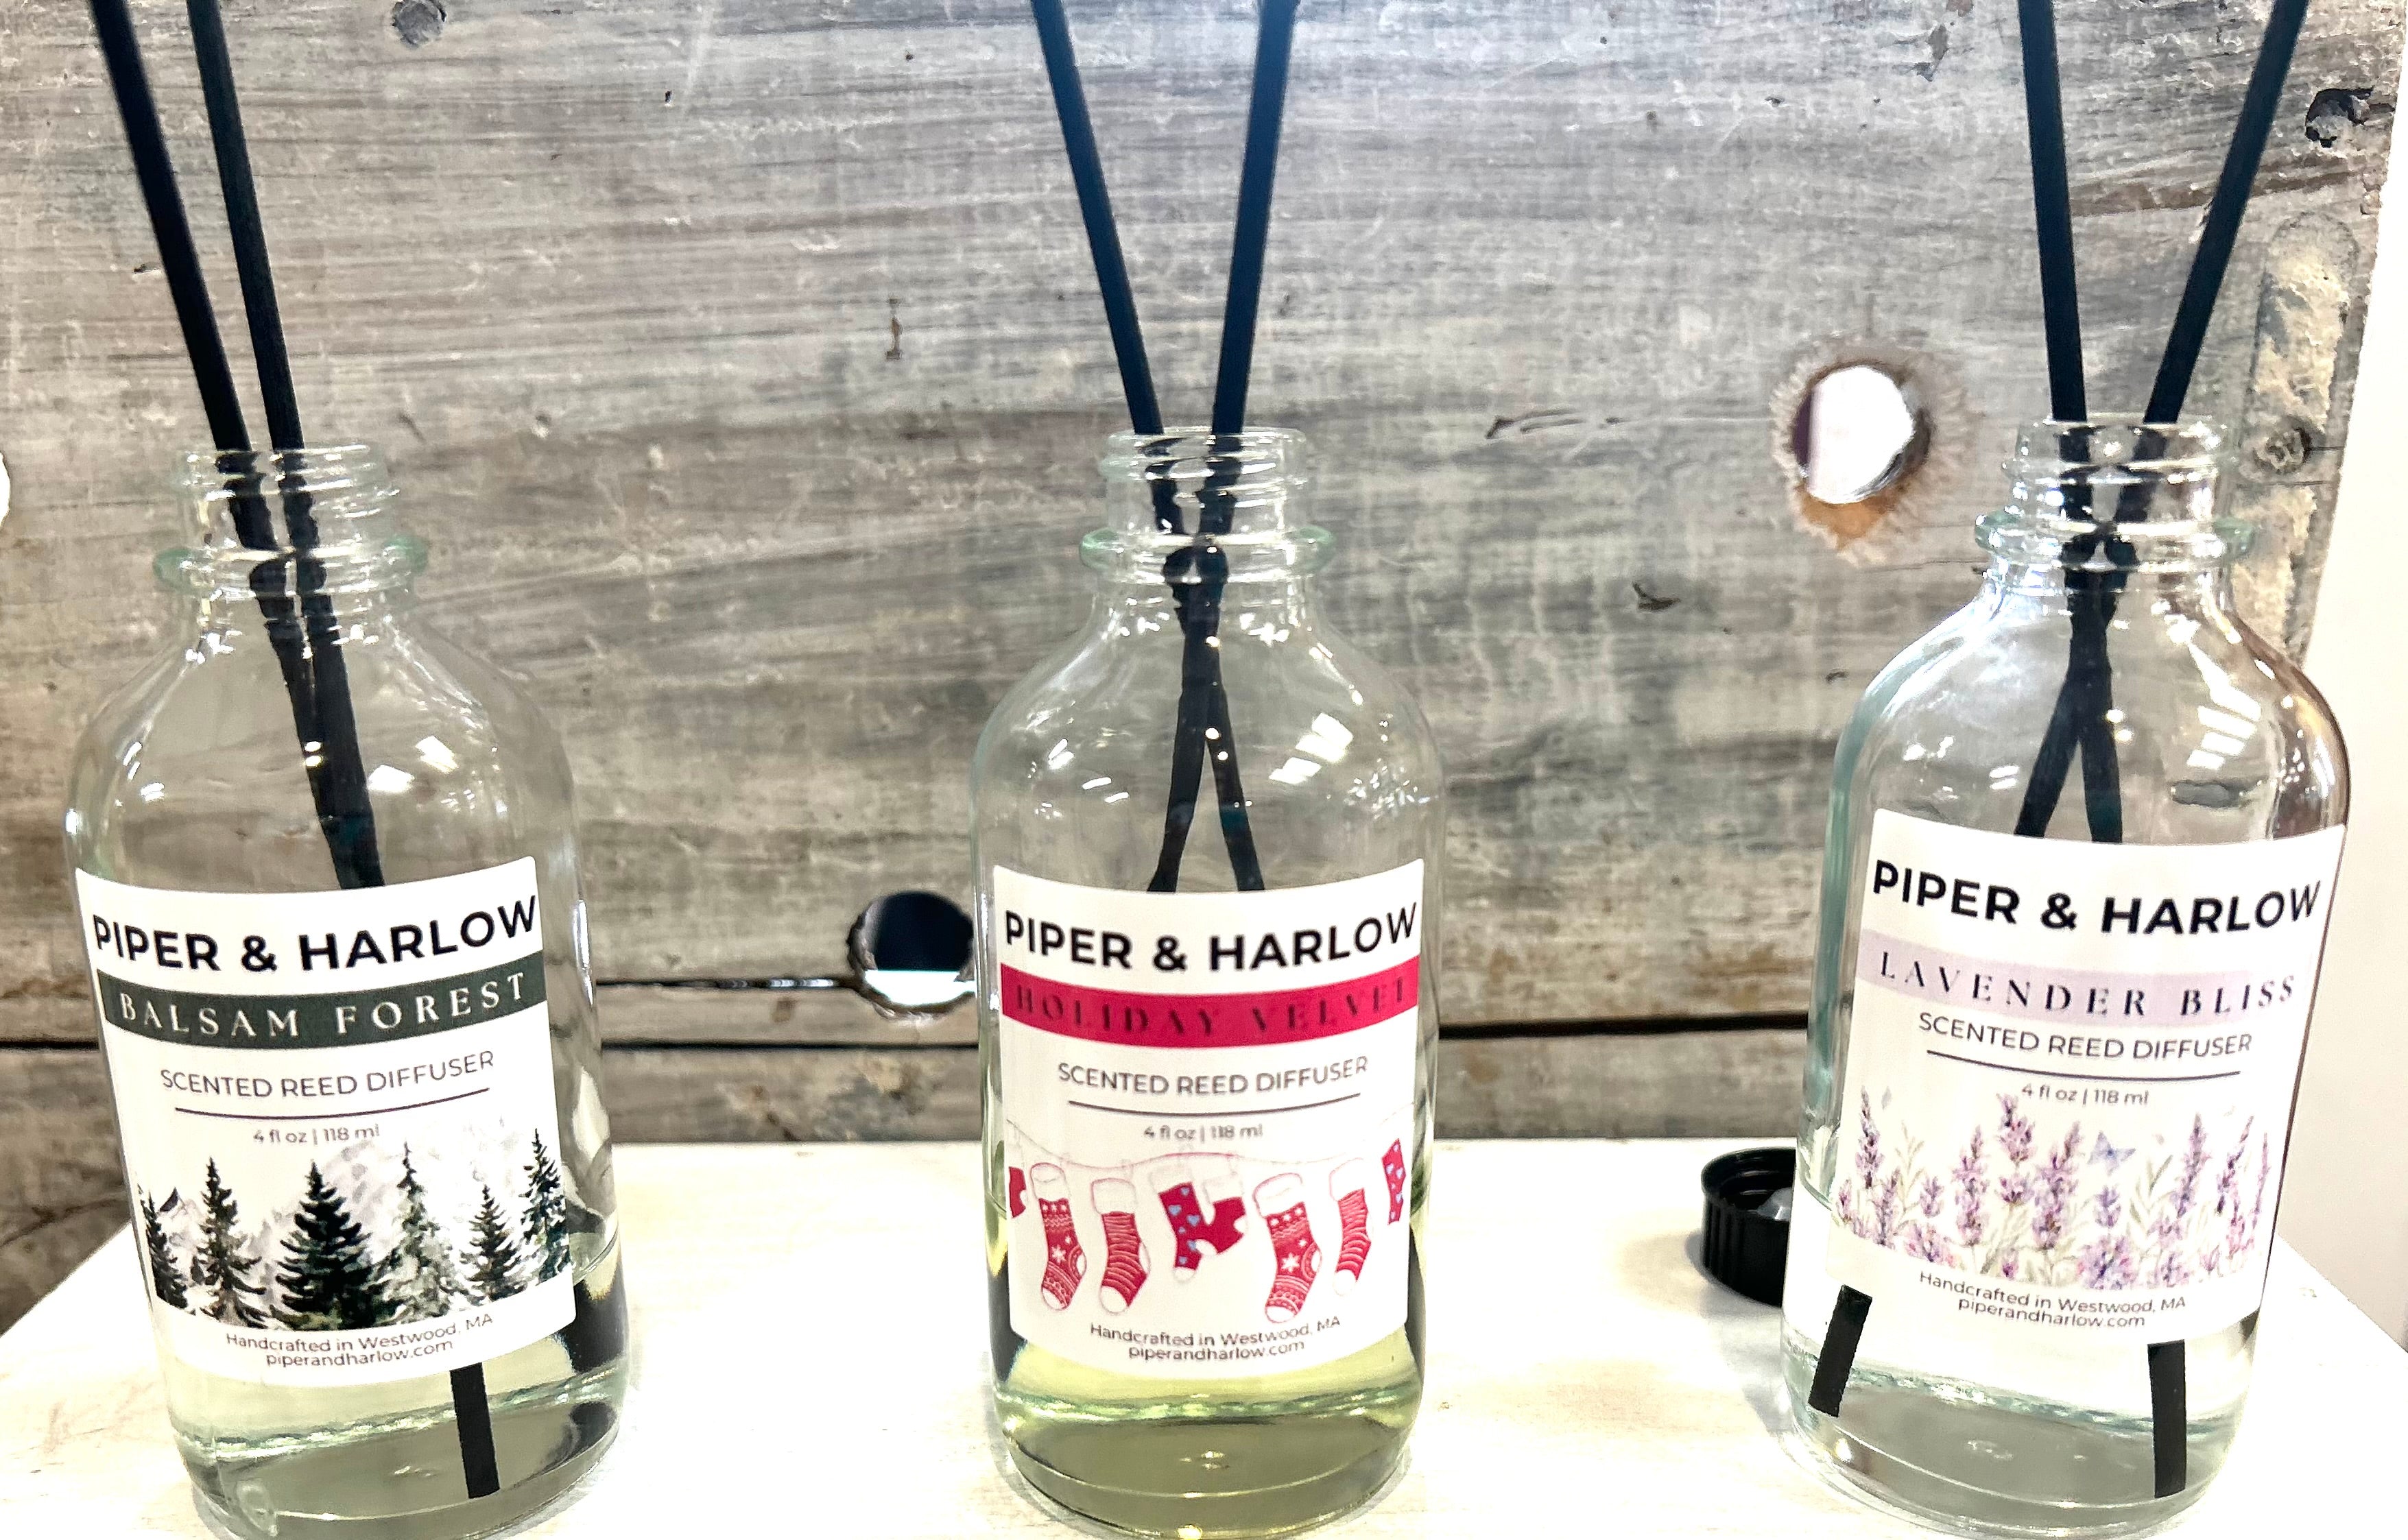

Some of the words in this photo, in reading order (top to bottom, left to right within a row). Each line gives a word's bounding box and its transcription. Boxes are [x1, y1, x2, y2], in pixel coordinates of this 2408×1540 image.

[1872, 860, 2020, 925] PIPER
[2040, 892, 2077, 931] &
[2101, 880, 2322, 935] HARLOW
[93, 913, 221, 972] PIPER
[241, 935, 278, 972] &
[299, 895, 536, 970] HARLOW
[1005, 909, 1133, 970] PIPER
[1154, 936, 1187, 972] &
[1209, 902, 1417, 972] HARLOW
[1881, 951, 2146, 1017] LAVENDER
[2180, 975, 2295, 1017] BLISS
[119, 991, 299, 1037] BALSAM
[335, 972, 526, 1034] FOREST
[1919, 1012, 2039, 1052] SCENTED
[2049, 1036, 2125, 1059] REED
[2133, 1034, 2252, 1060] DIFFUSER
[160, 1068, 272, 1098] SCENTED
[282, 1074, 358, 1098] REED
[368, 1050, 494, 1092] DIFFUSER
[1058, 1061, 1169, 1094] SCENTED
[1178, 1074, 1248, 1095] REED
[1256, 1056, 1368, 1092] DIFFUSER
[2022, 1083, 2034, 1098] 4
[2038, 1084, 2051, 1100] fl
[2055, 1089, 2077, 1101] oz
[2095, 1089, 2119, 1104] 118
[2124, 1090, 2148, 1105] ml
[252, 1130, 265, 1144] 4
[268, 1128, 282, 1142] fl
[285, 1131, 306, 1144] oz
[324, 1126, 349, 1141] 118
[355, 1123, 380, 1140] ml
[1143, 1127, 1154, 1139] 4
[1158, 1126, 1170, 1140] fl
[1174, 1129, 1195, 1141] oz
[1211, 1125, 1234, 1140] 118
[1239, 1123, 1263, 1138] ml
[1920, 1271, 2030, 1308] Handcrafted
[2034, 1295, 2051, 1309] in
[2058, 1297, 2156, 1312] Westwood,
[2160, 1296, 2186, 1310] MA
[226, 1333, 331, 1352] Handcrafted
[336, 1338, 353, 1350] in
[357, 1323, 460, 1349] Westwood,
[466, 1312, 493, 1328] MA
[1090, 1323, 1193, 1345] Handcrafted
[1199, 1332, 1215, 1346] in
[1220, 1324, 1313, 1345] Westwood,
[1317, 1316, 1341, 1330] MA
[1958, 1298, 2145, 1327] piperandharlow.com
[266, 1339, 453, 1367] piperandharlow.com
[1128, 1341, 1304, 1360] piperandharlow.com
